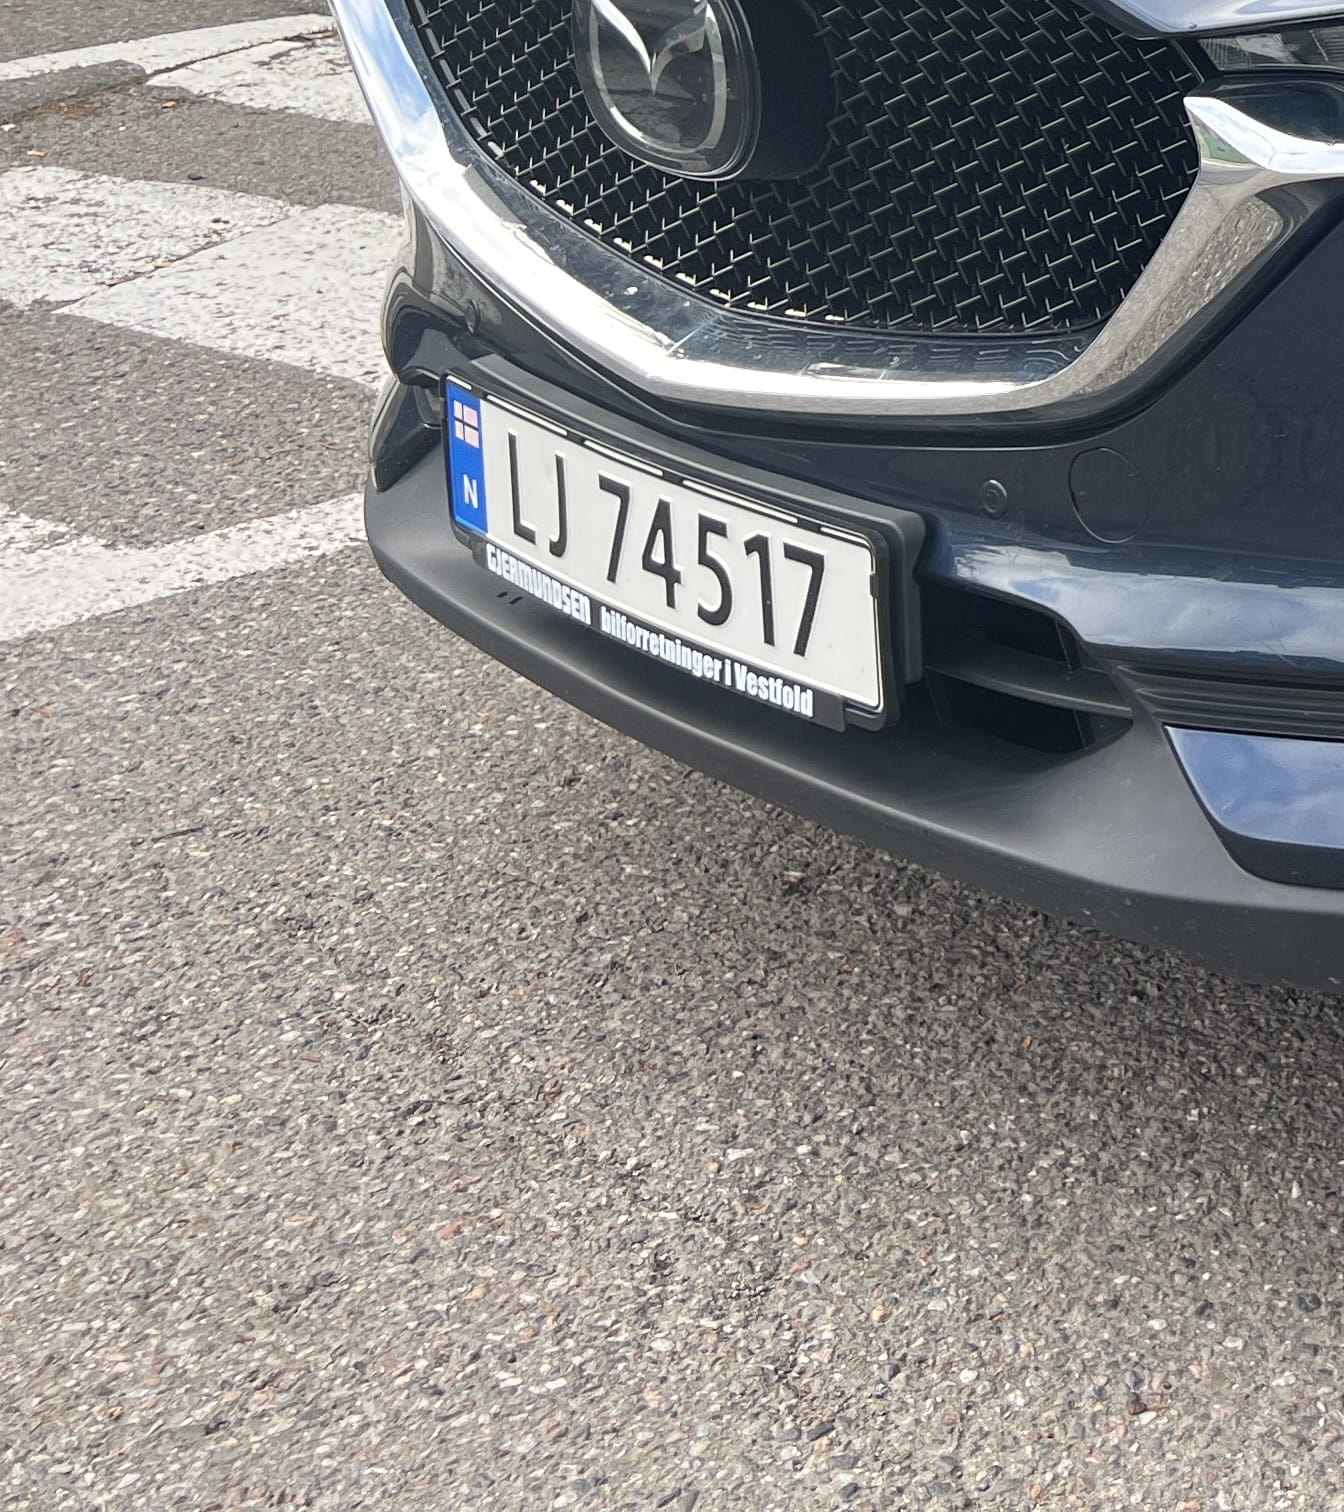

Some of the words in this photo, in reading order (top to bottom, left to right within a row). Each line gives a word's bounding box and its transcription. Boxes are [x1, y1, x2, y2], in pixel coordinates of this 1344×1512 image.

[462, 473, 479, 509] N
[506, 431, 568, 559] LJ
[598, 473, 826, 658] 74517
[600, 605, 722, 683] bilforretninger
[723, 659, 733, 687] i
[733, 663, 814, 719] Vestfold
